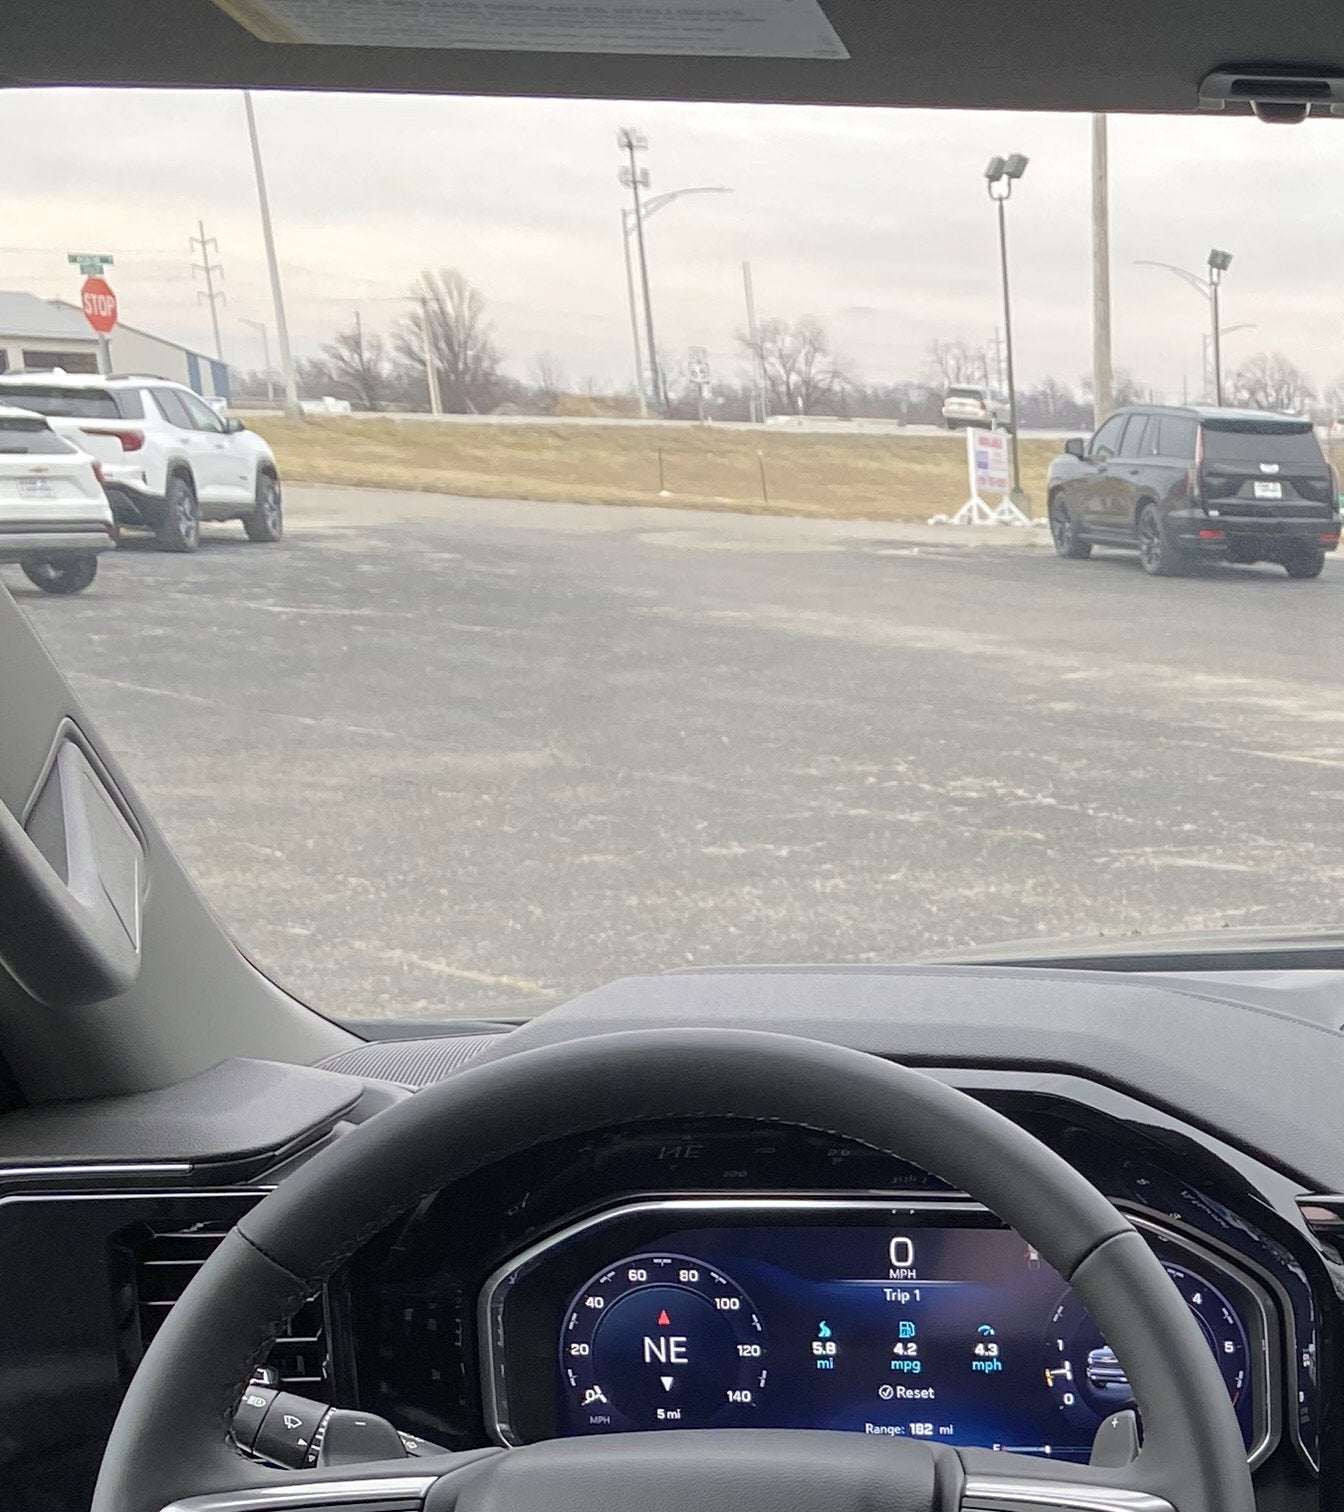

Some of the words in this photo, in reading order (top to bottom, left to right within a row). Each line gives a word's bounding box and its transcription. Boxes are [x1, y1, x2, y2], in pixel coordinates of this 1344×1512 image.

[84, 292, 115, 317] STOP
[889, 1237, 914, 1267] 0
[627, 1269, 647, 1281] 60
[679, 1270, 699, 1282] 80
[889, 1269, 917, 1280] MPH
[585, 1296, 604, 1309] 40
[883, 1289, 911, 1304] Trip
[914, 1289, 920, 1301] 1
[1192, 1293, 1203, 1305] 4
[714, 1297, 740, 1310] 100
[570, 1343, 589, 1356] 20
[643, 1336, 689, 1363] NE
[737, 1345, 761, 1357] 120
[812, 1341, 837, 1355] 5.8
[893, 1342, 918, 1356] 4.2
[974, 1343, 999, 1357] 4.3
[1057, 1340, 1064, 1351] 1
[1224, 1342, 1234, 1353] 5
[816, 1358, 834, 1369] mi
[891, 1359, 921, 1374] mpg
[972, 1358, 1002, 1374] mph
[726, 1390, 752, 1402] 140
[896, 1386, 935, 1399] Reset
[1063, 1394, 1074, 1405] 0
[589, 1416, 611, 1424] MPH
[657, 1409, 665, 1419] 5
[666, 1409, 681, 1419] mi
[865, 1423, 905, 1437] Range:
[909, 1423, 933, 1435] 182
[939, 1424, 954, 1435] mi
